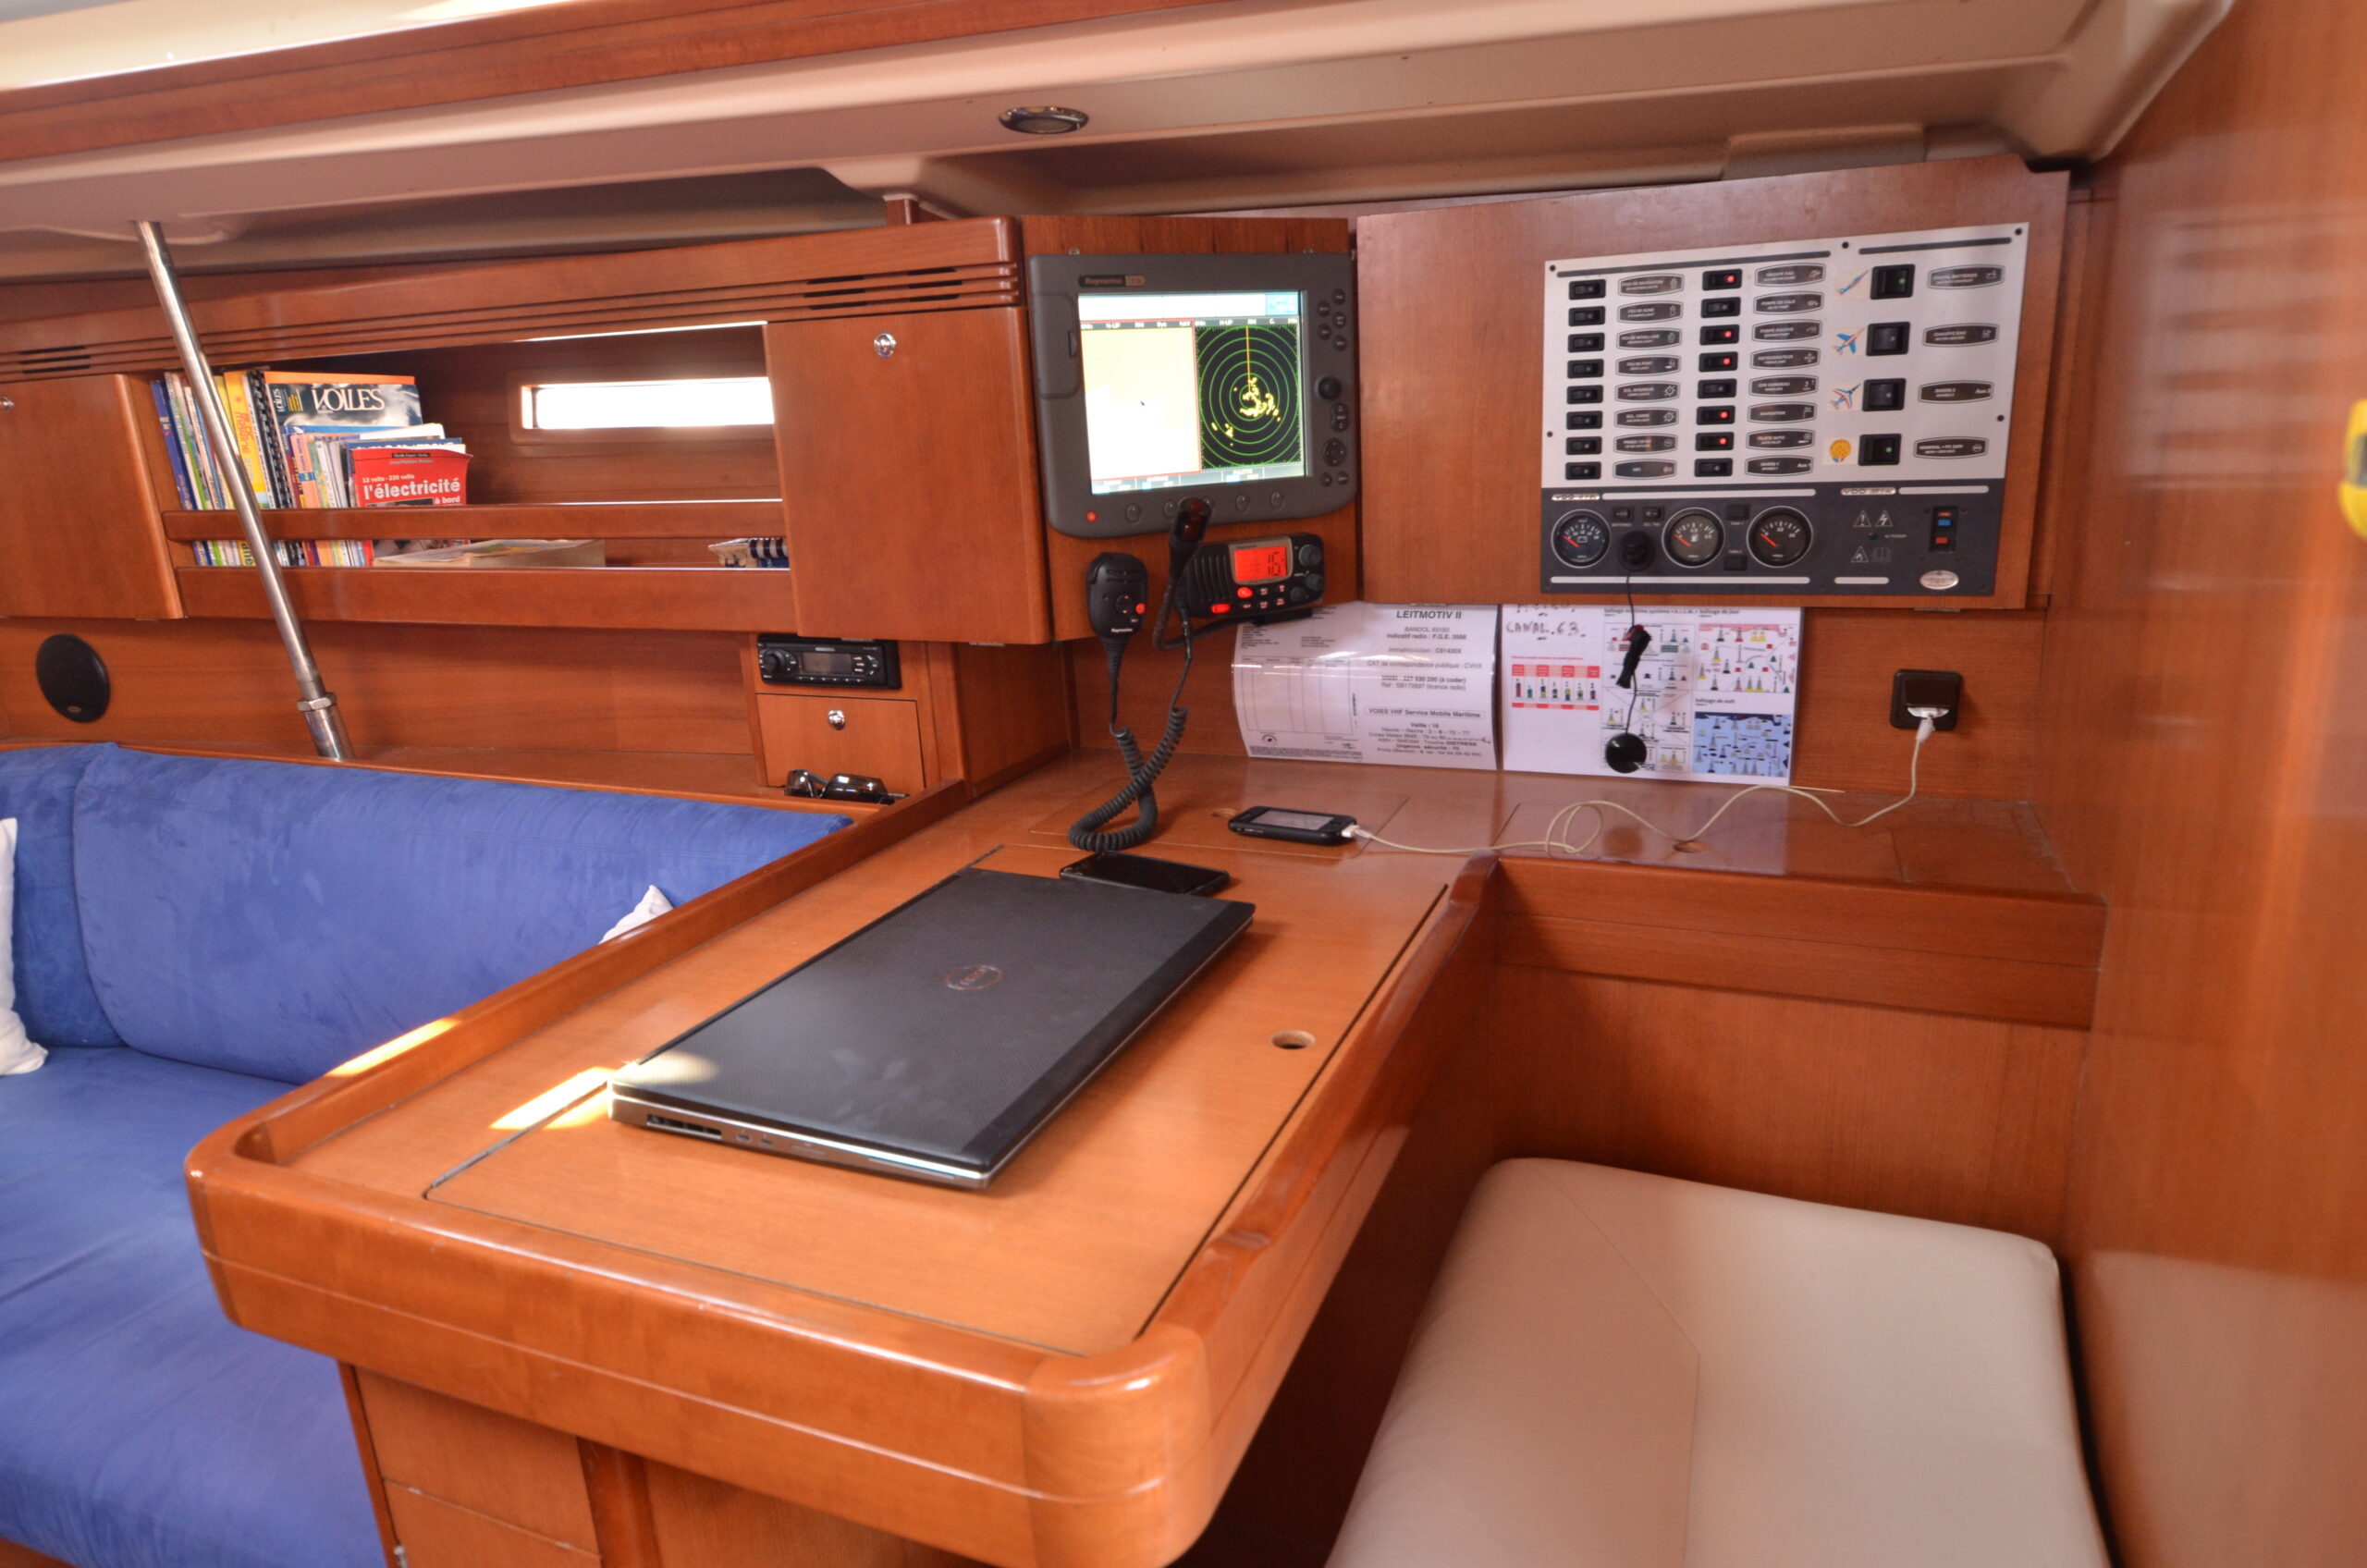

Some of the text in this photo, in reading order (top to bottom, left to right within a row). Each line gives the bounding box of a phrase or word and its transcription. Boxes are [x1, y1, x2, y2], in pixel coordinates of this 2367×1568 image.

[311, 387, 386, 411] VOILES
[362, 477, 461, 500] l'électricité
[442, 496, 460, 504] bord
[1396, 610, 1453, 619] LEITMOTIV
